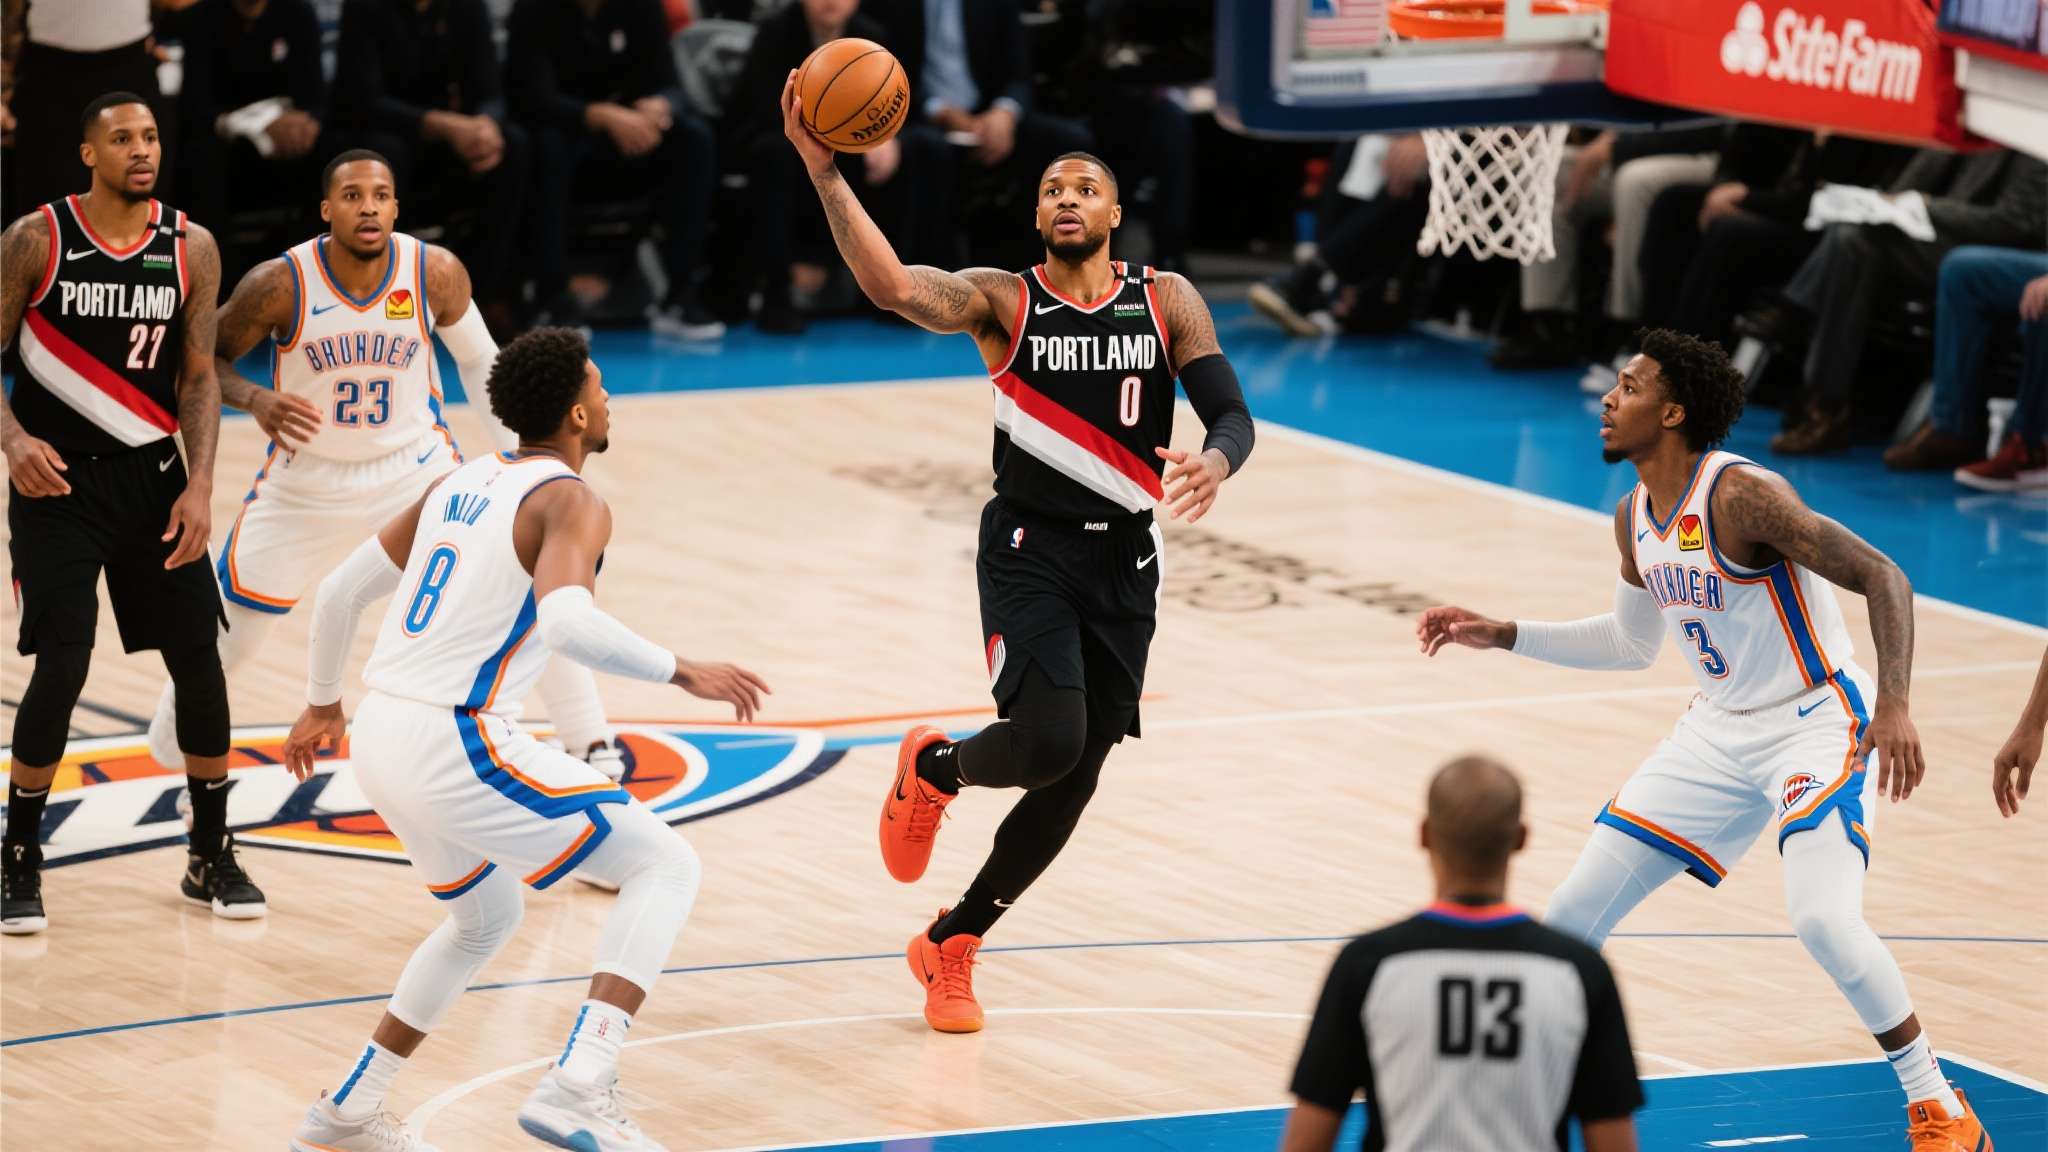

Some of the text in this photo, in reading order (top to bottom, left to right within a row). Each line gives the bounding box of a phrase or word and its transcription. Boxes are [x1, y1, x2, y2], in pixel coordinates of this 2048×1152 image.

[334, 378, 393, 428] 23
[1120, 376, 1142, 427] 0
[402, 541, 460, 638] 8
[1680, 618, 1729, 679] 3
